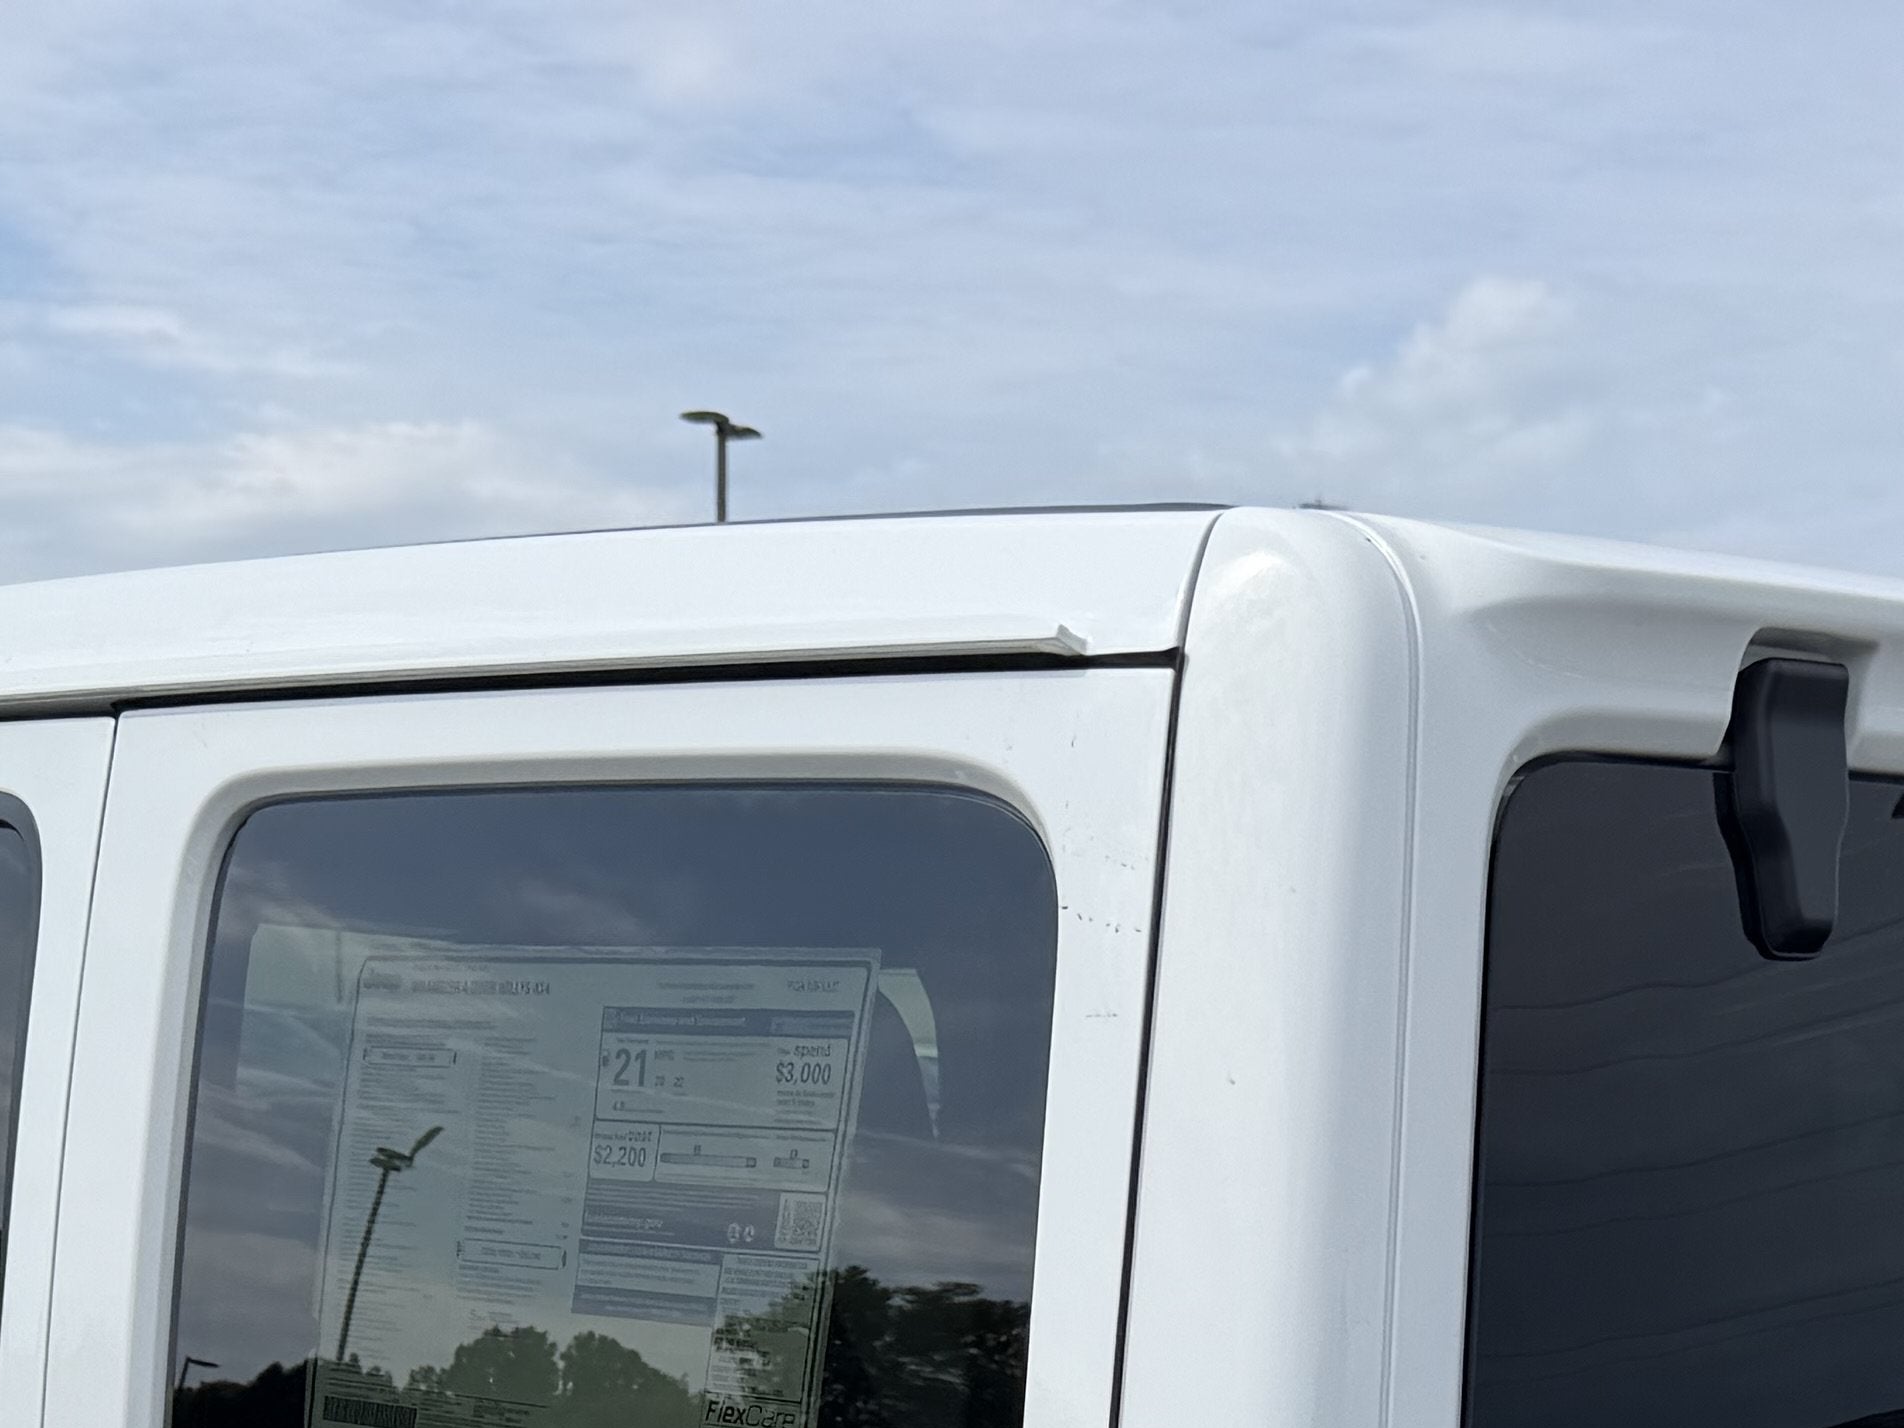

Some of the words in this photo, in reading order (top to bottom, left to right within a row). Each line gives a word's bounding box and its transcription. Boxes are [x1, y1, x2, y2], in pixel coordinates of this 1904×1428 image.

[613, 1048, 648, 1087] 21
[775, 1062, 832, 1086] $3,000
[593, 1145, 647, 1169] $2,200
